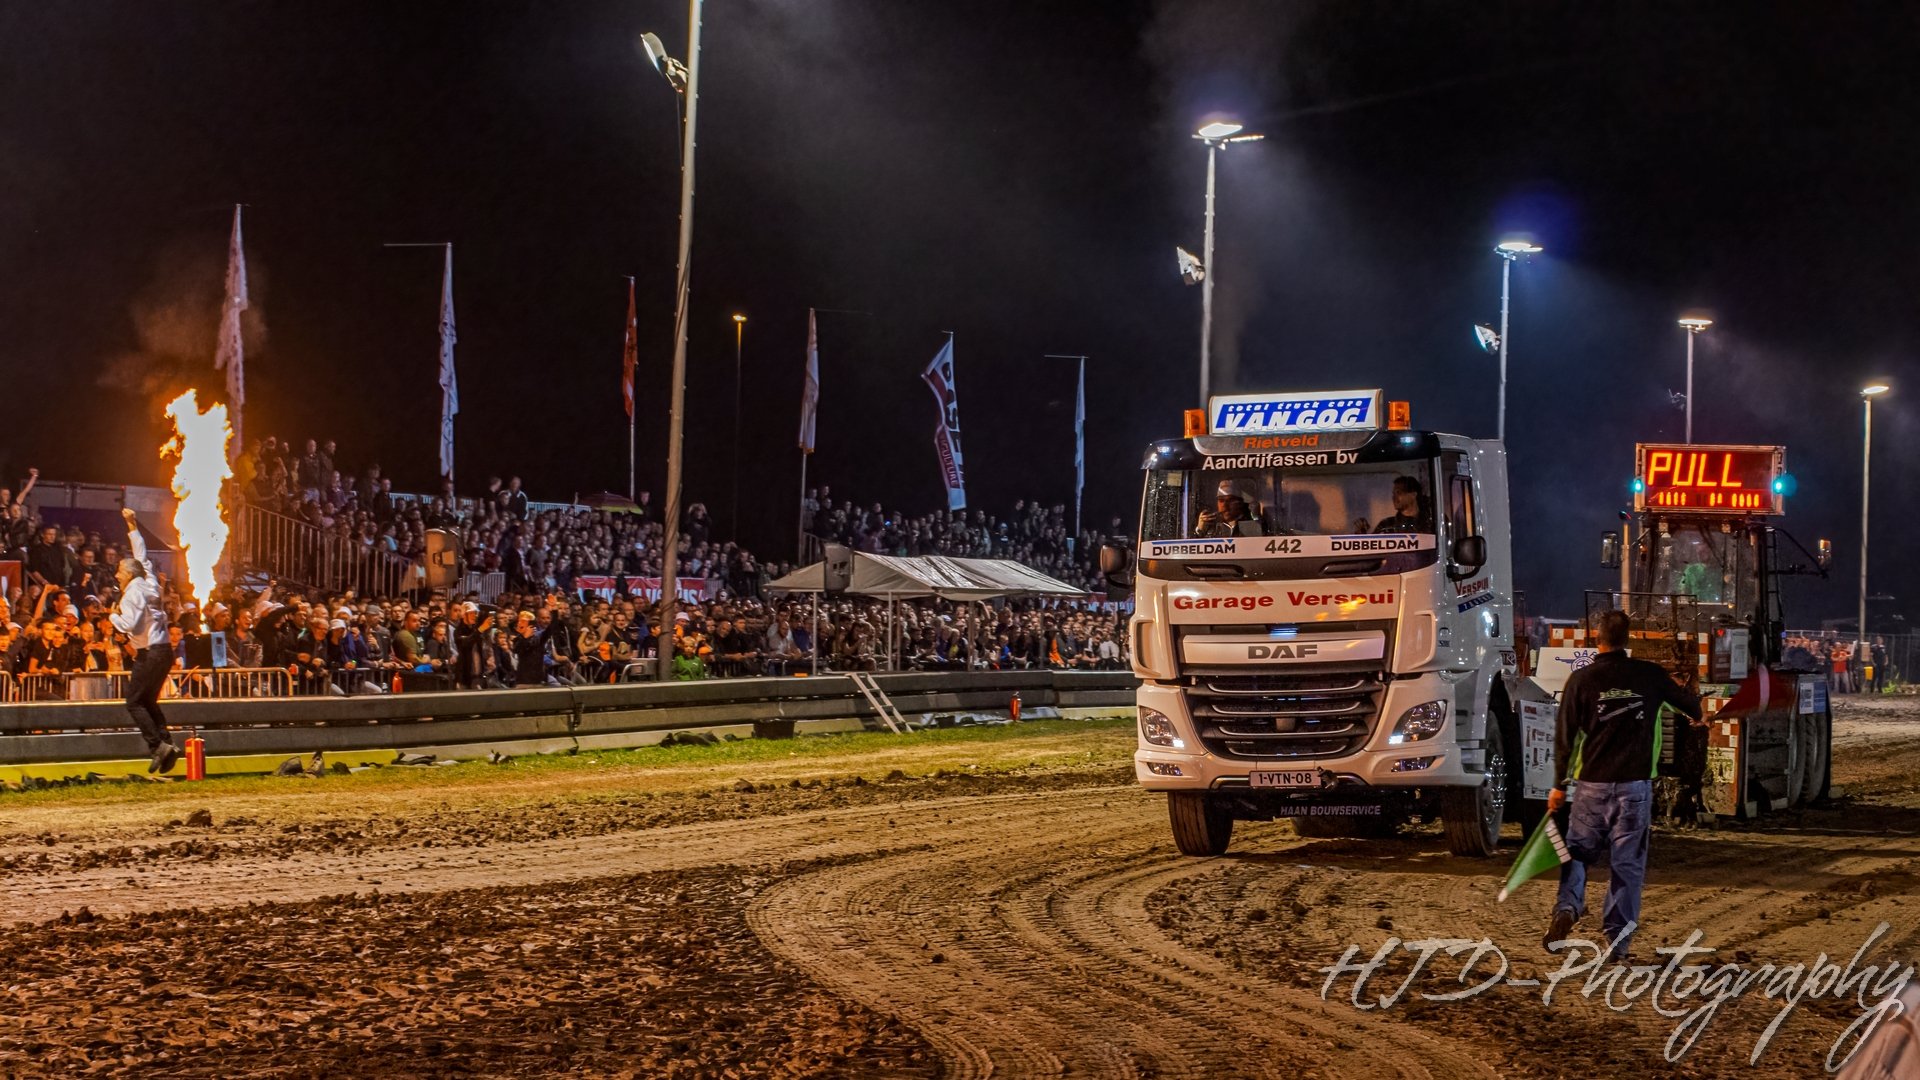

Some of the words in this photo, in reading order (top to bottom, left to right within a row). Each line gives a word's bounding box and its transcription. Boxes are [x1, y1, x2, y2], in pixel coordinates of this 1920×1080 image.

[1244, 434, 1319, 449] Rietveld
[1202, 452, 1328, 471] Aandrijfassen
[1336, 450, 1359, 464] bv
[1647, 452, 1742, 487] PULL
[1152, 543, 1236, 556] DUBBELDAM
[1264, 539, 1302, 554] 442
[1331, 539, 1419, 552] DUBBELDAM
[1173, 594, 1274, 611] Garage
[1287, 590, 1394, 606] Verspui
[1247, 644, 1317, 659] DAF
[1258, 773, 1312, 784] 1-VTN-08
[1281, 805, 1308, 815] HAAN
[1310, 805, 1381, 815] BOUWSERVICE
